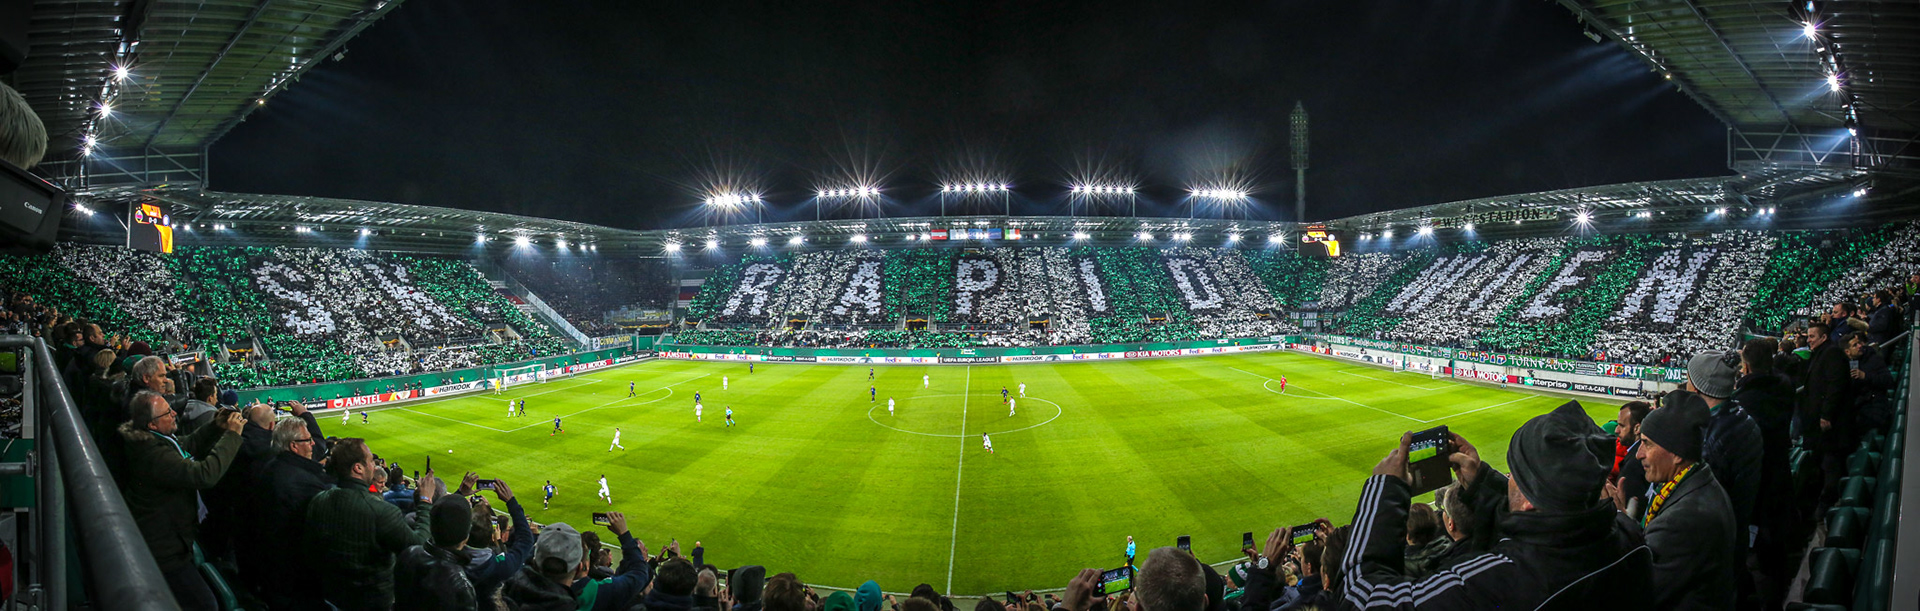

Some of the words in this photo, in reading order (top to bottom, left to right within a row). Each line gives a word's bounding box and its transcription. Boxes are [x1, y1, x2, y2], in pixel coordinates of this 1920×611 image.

[24, 201, 42, 214] Canon
[723, 258, 1225, 316] RAPID
[1386, 249, 1716, 323] WIEN
[1463, 369, 1475, 378] KIA
[1526, 377, 1567, 388] enterprise
[345, 394, 382, 407] AMSTEL
